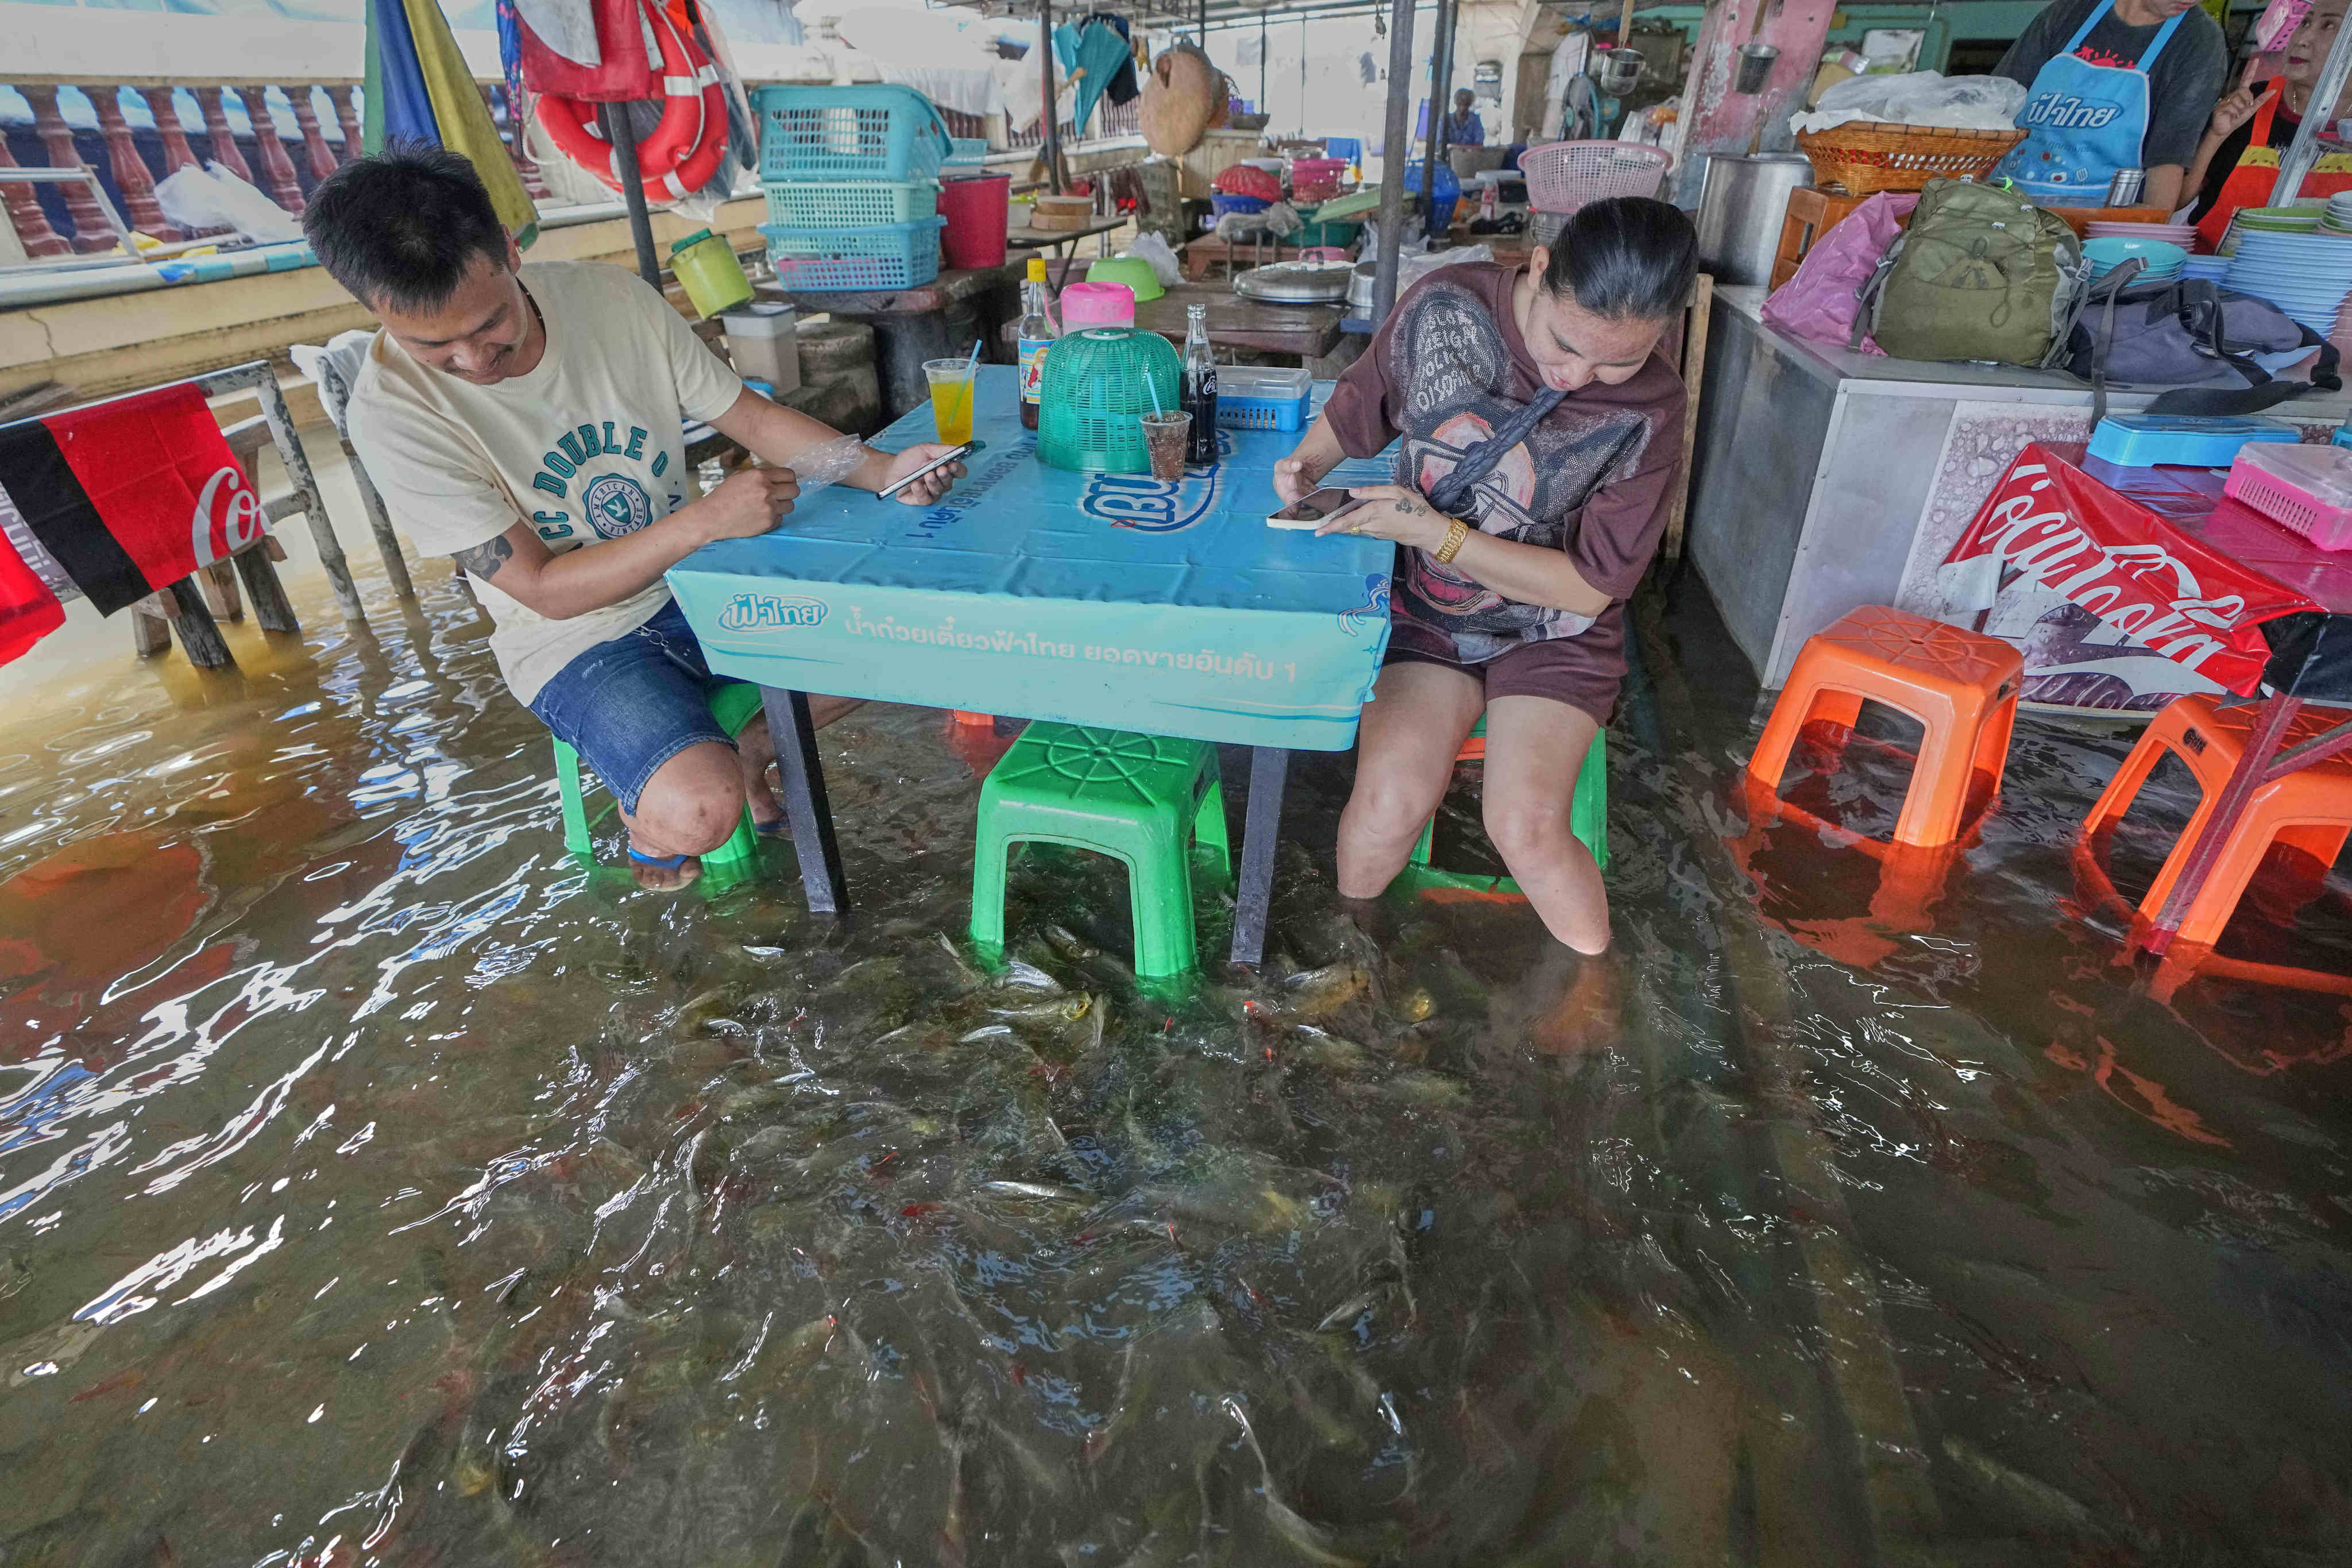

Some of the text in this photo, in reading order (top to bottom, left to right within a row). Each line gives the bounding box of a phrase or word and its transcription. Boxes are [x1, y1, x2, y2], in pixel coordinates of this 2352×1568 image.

[2026, 92, 2118, 128] ฟ้าไทย
[533, 422, 648, 499] DOUBLE
[594, 483, 635, 518] AMERICAN
[609, 507, 644, 535] VINTAGE
[725, 593, 824, 628] ฟ้าไทย
[1084, 645, 1274, 681] ยอดขายอันดับ
[1283, 662, 1296, 683] 1
